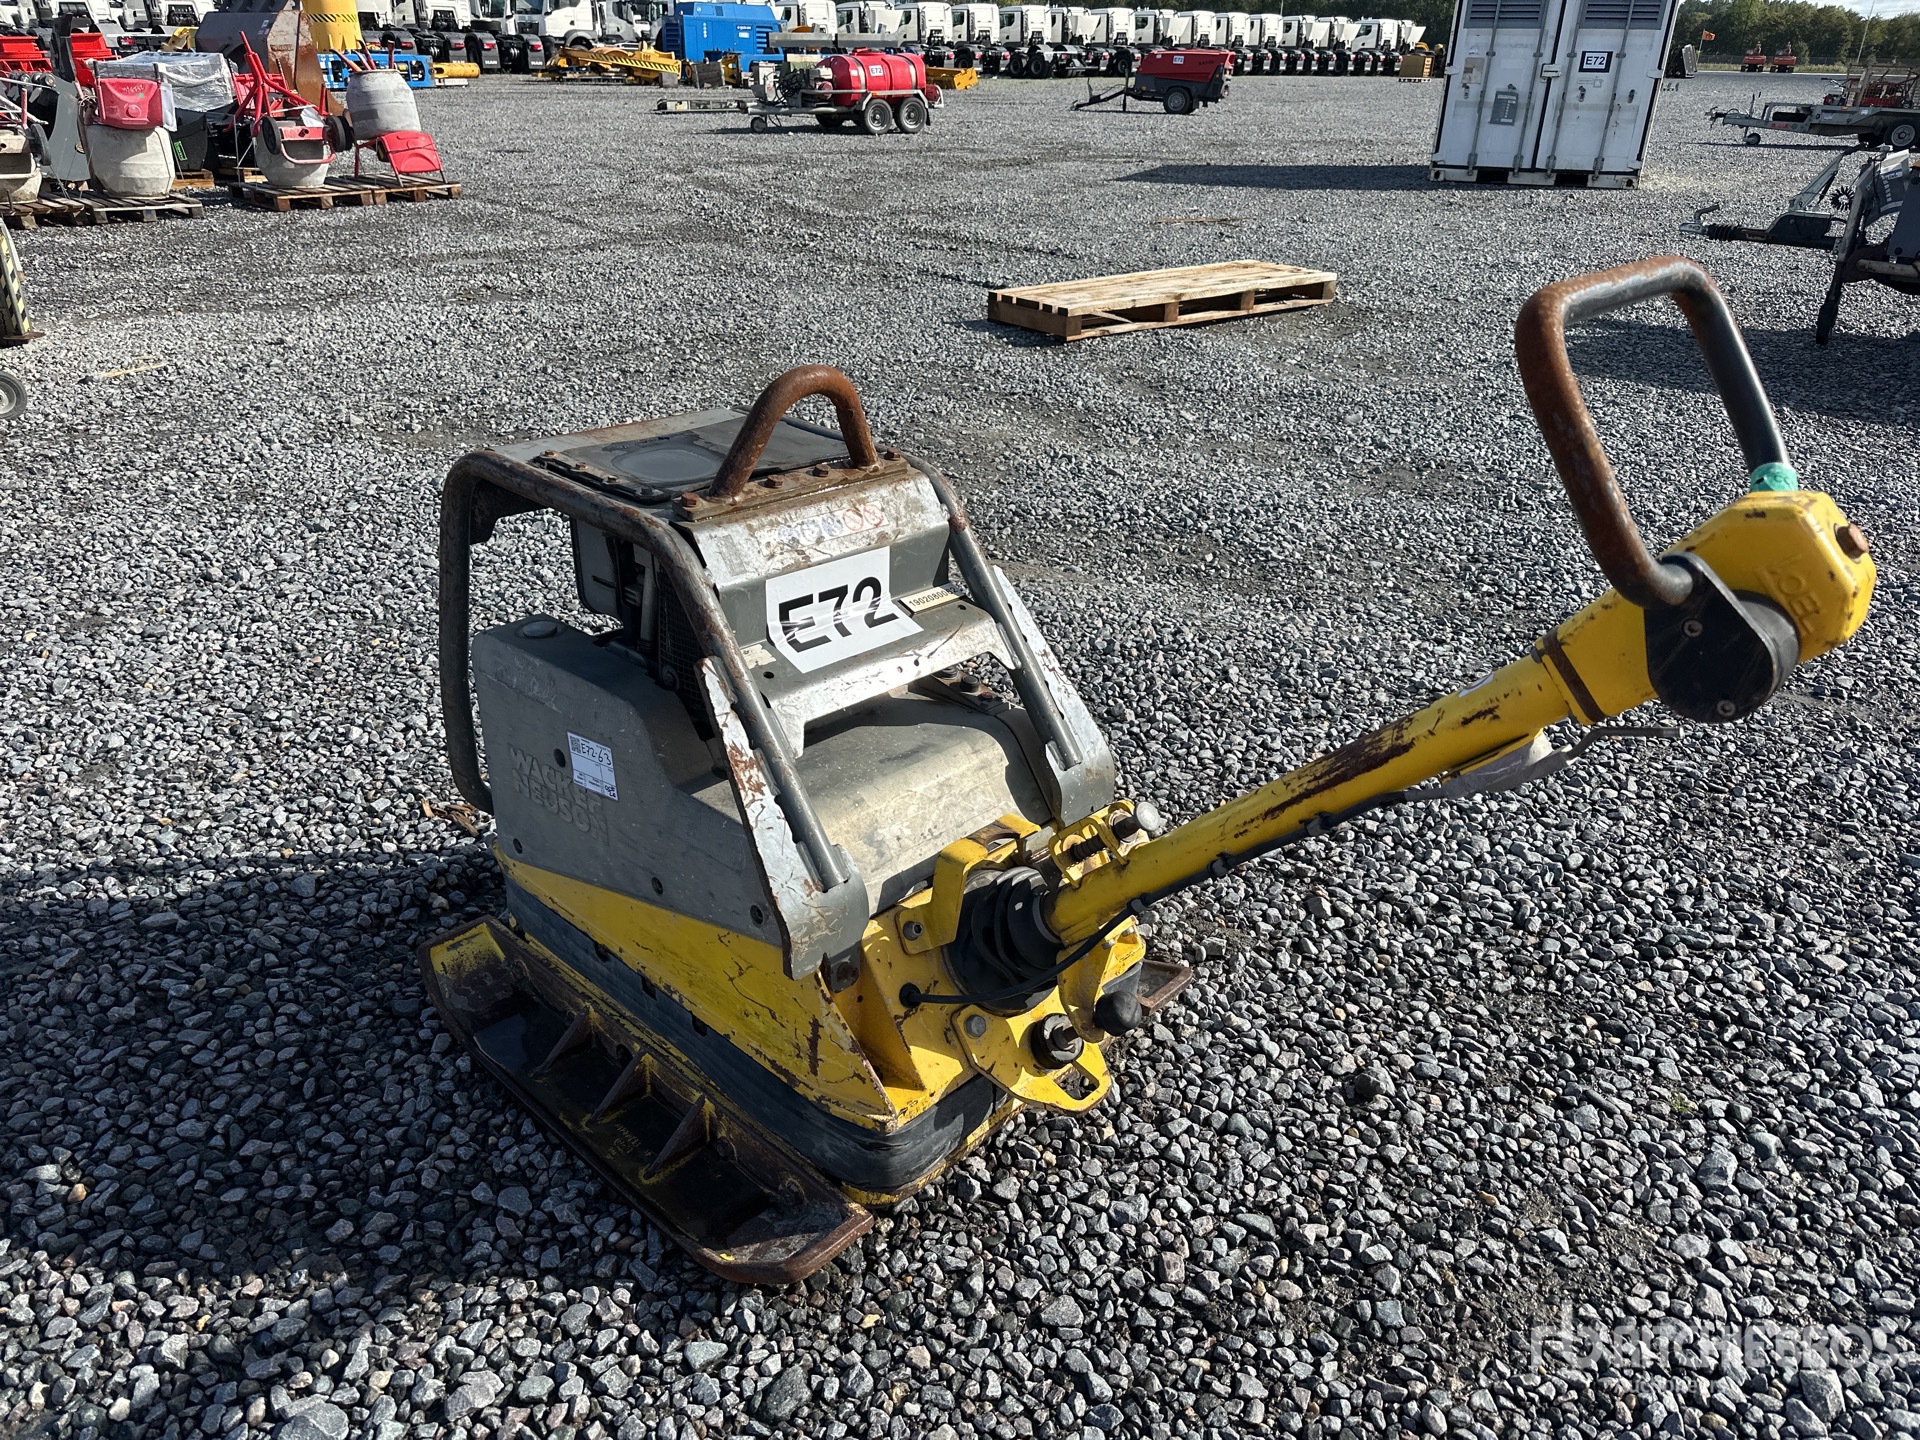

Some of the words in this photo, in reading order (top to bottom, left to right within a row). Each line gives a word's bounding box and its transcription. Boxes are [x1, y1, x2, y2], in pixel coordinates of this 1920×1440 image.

[870, 67, 882, 75] E72
[1585, 56, 1606, 66] E72
[779, 576, 899, 653] E72
[512, 768, 609, 847] NEUSON
